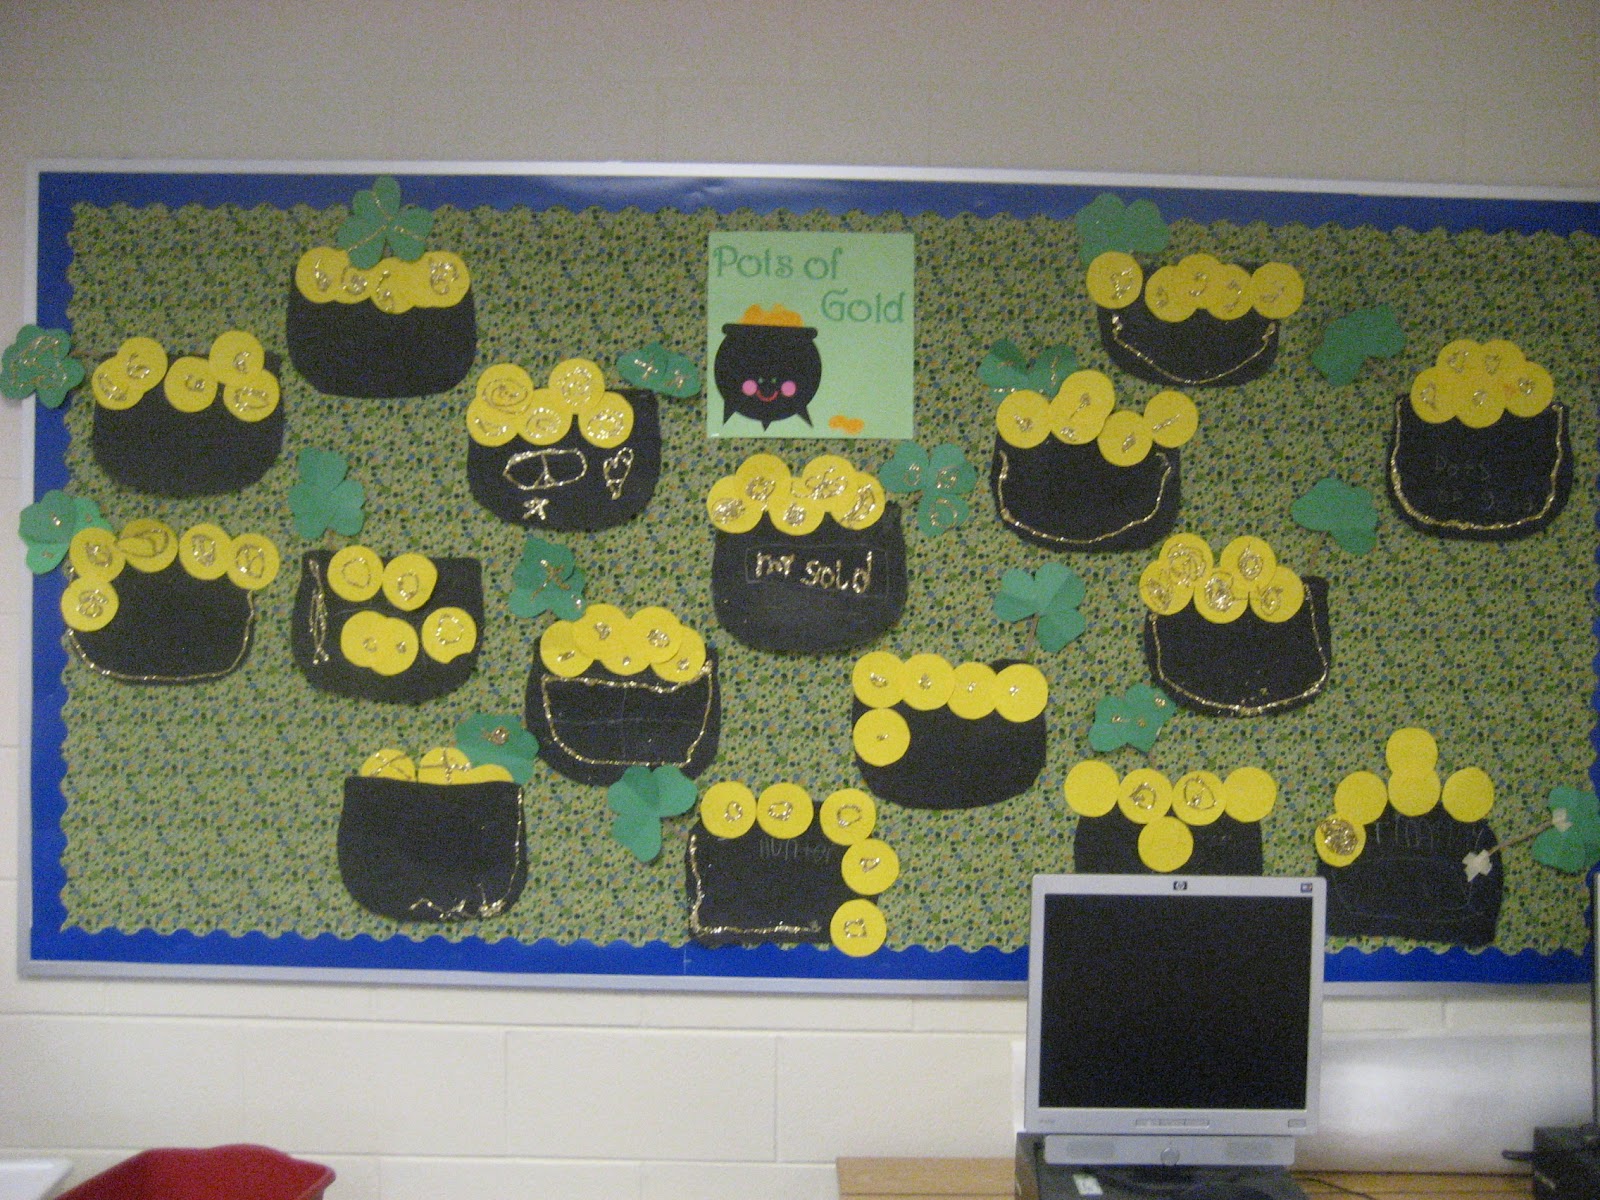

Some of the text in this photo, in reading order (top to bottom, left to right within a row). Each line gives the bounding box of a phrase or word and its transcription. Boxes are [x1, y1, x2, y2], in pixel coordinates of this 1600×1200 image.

[713, 245, 843, 280] Pots of
[820, 287, 905, 323] Gold
